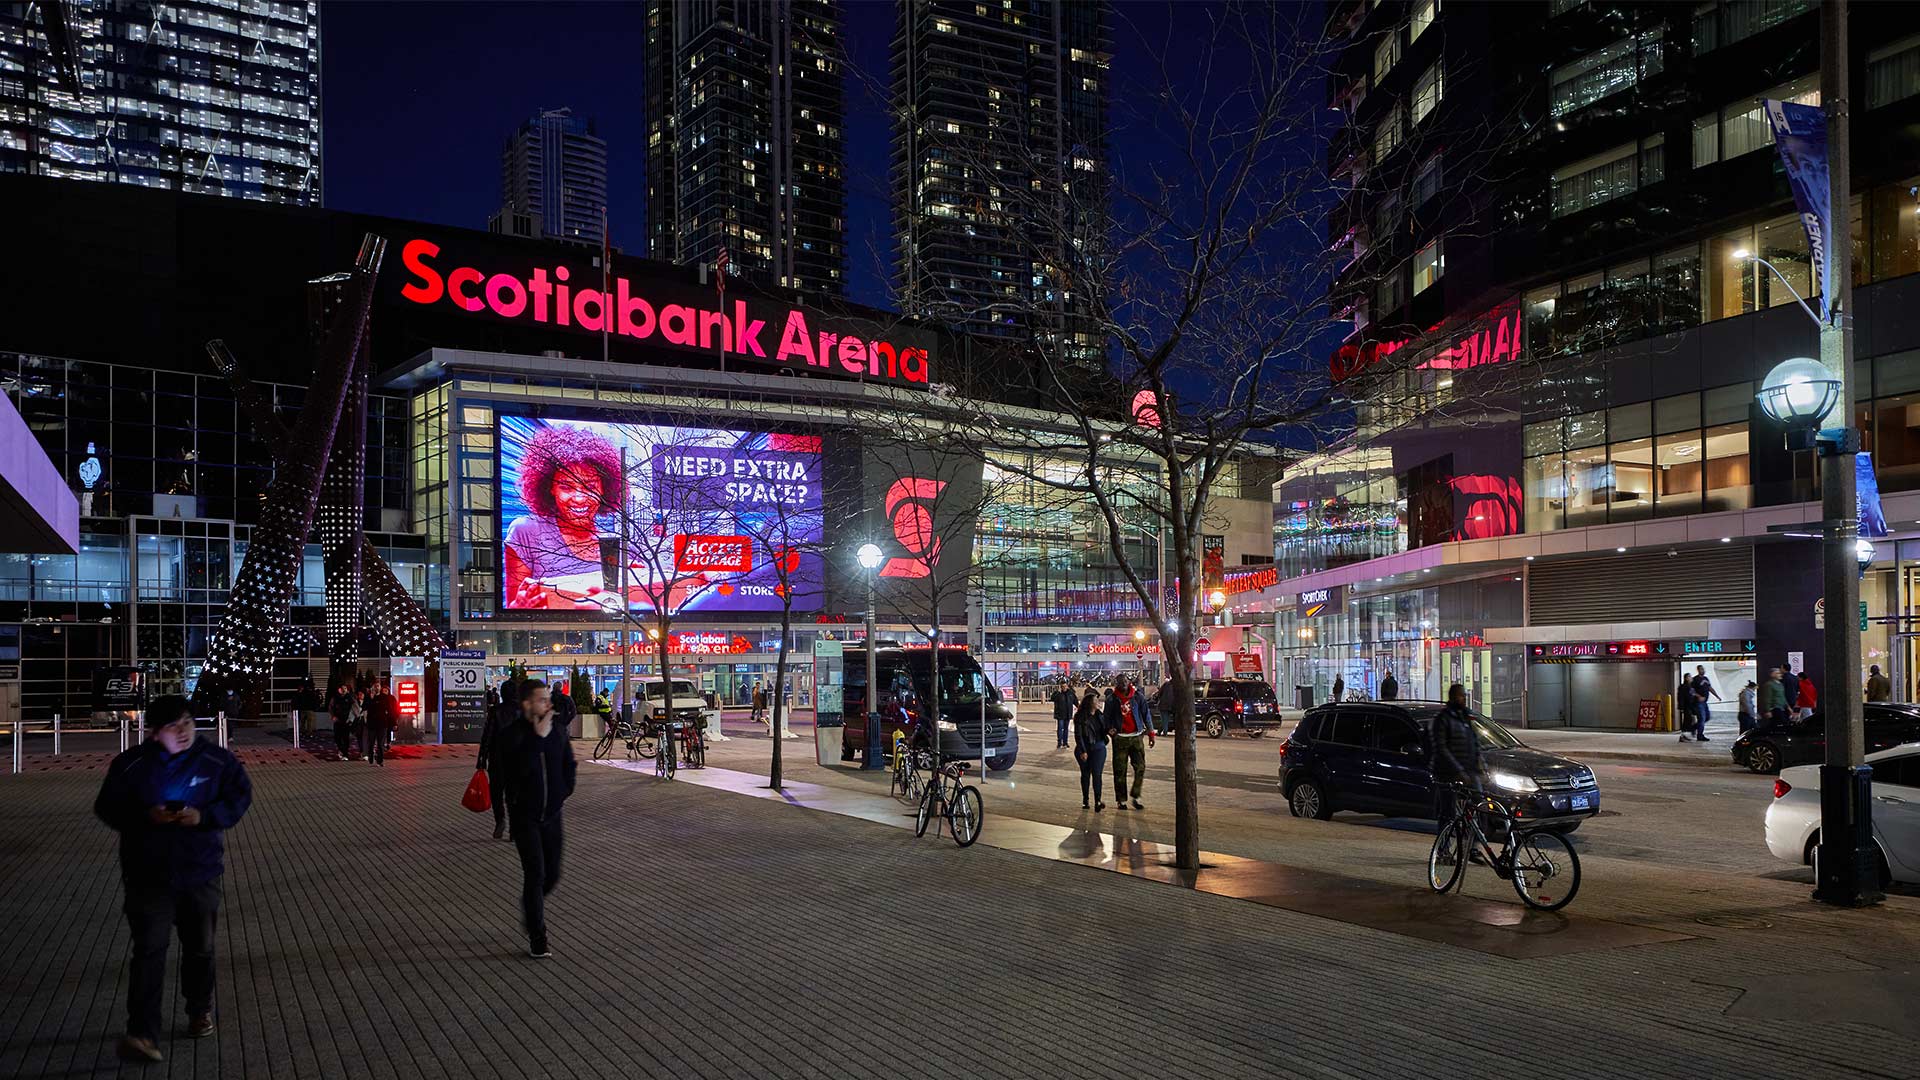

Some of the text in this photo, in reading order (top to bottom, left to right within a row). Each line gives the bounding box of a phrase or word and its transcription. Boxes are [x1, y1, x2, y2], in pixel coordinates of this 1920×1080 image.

[1774, 111, 1784, 122] 16
[401, 239, 928, 383] Scotiabank Arena
[664, 456, 808, 481] NEED EXTRA
[725, 482, 808, 504] SPACE?
[686, 555, 743, 566] STORAGE
[1088, 643, 1136, 654] Scotiabank
[1552, 645, 1598, 655] EXIT ONLY
[1685, 641, 1722, 652] ENTER
[451, 669, 477, 684] $30
